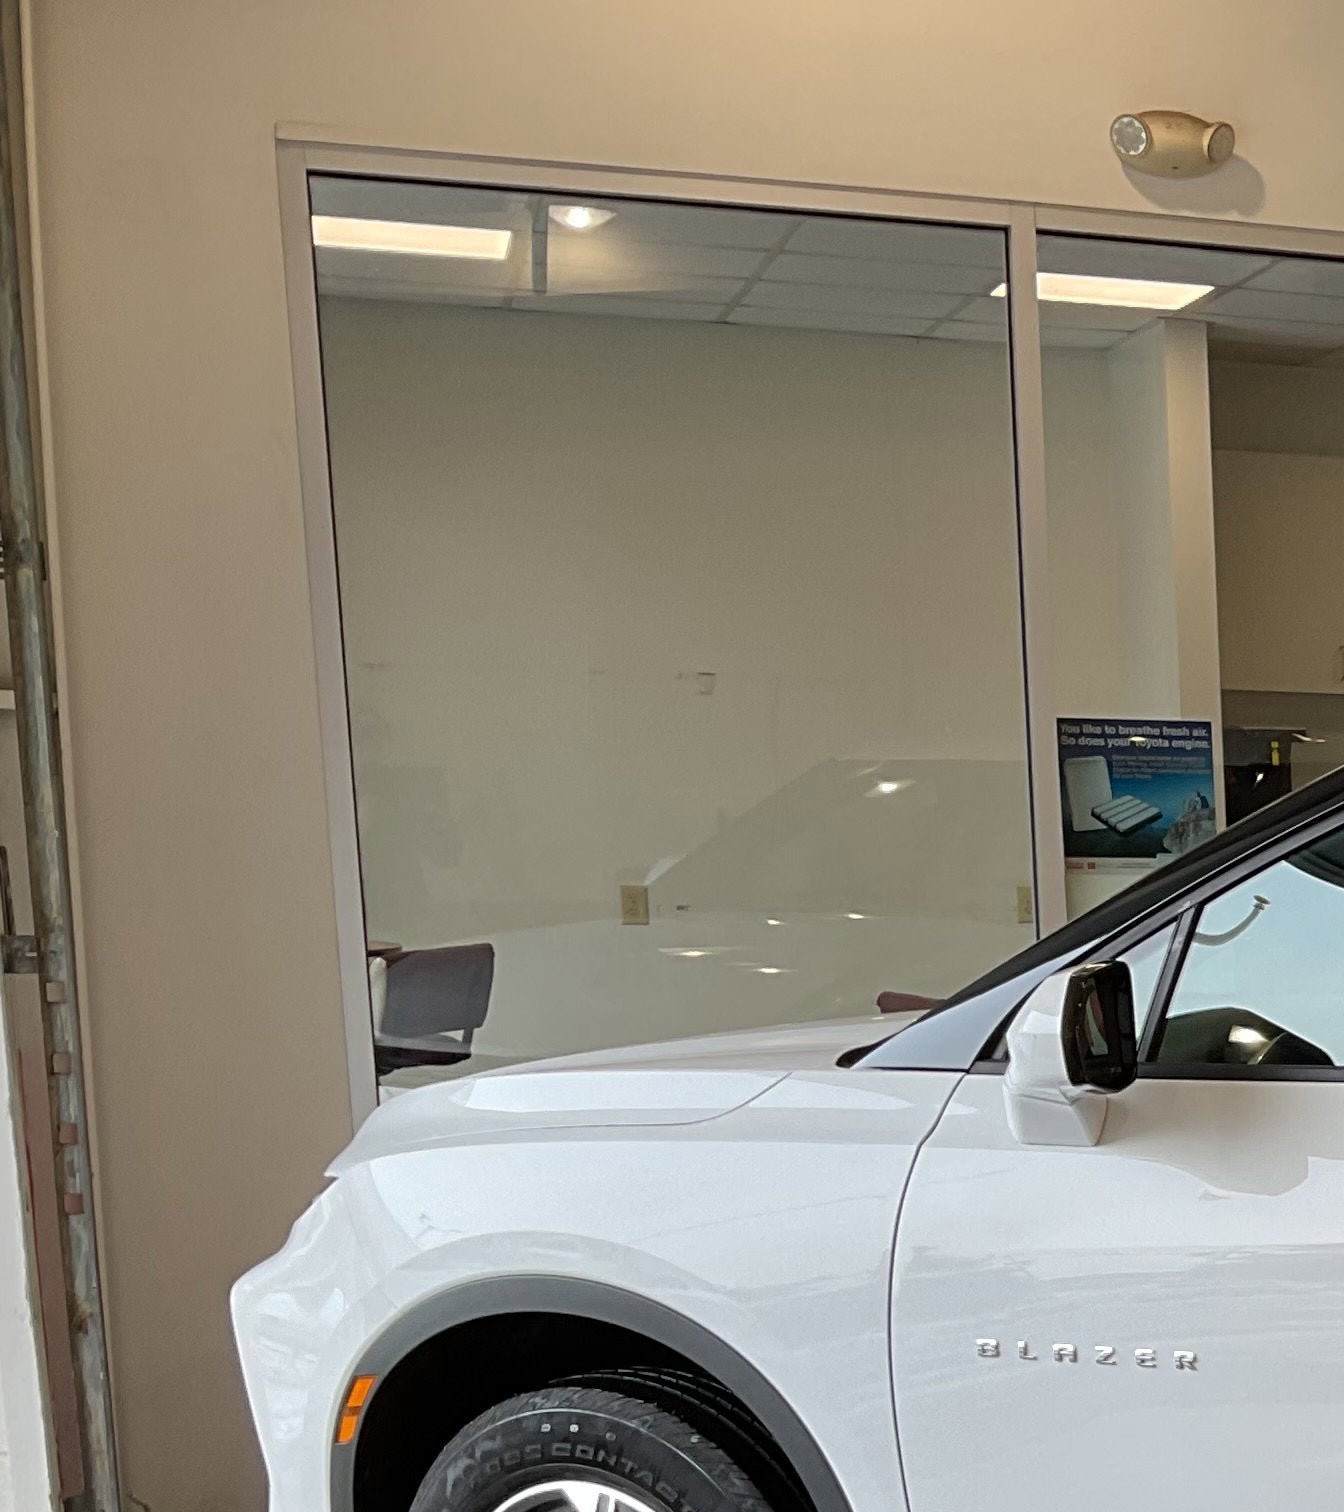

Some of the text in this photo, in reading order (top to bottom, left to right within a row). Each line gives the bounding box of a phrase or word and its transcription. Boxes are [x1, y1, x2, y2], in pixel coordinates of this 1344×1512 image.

[1104, 725, 1116, 735] to
[1060, 735, 1076, 745] So
[976, 1338, 1198, 1371] BLAZER
